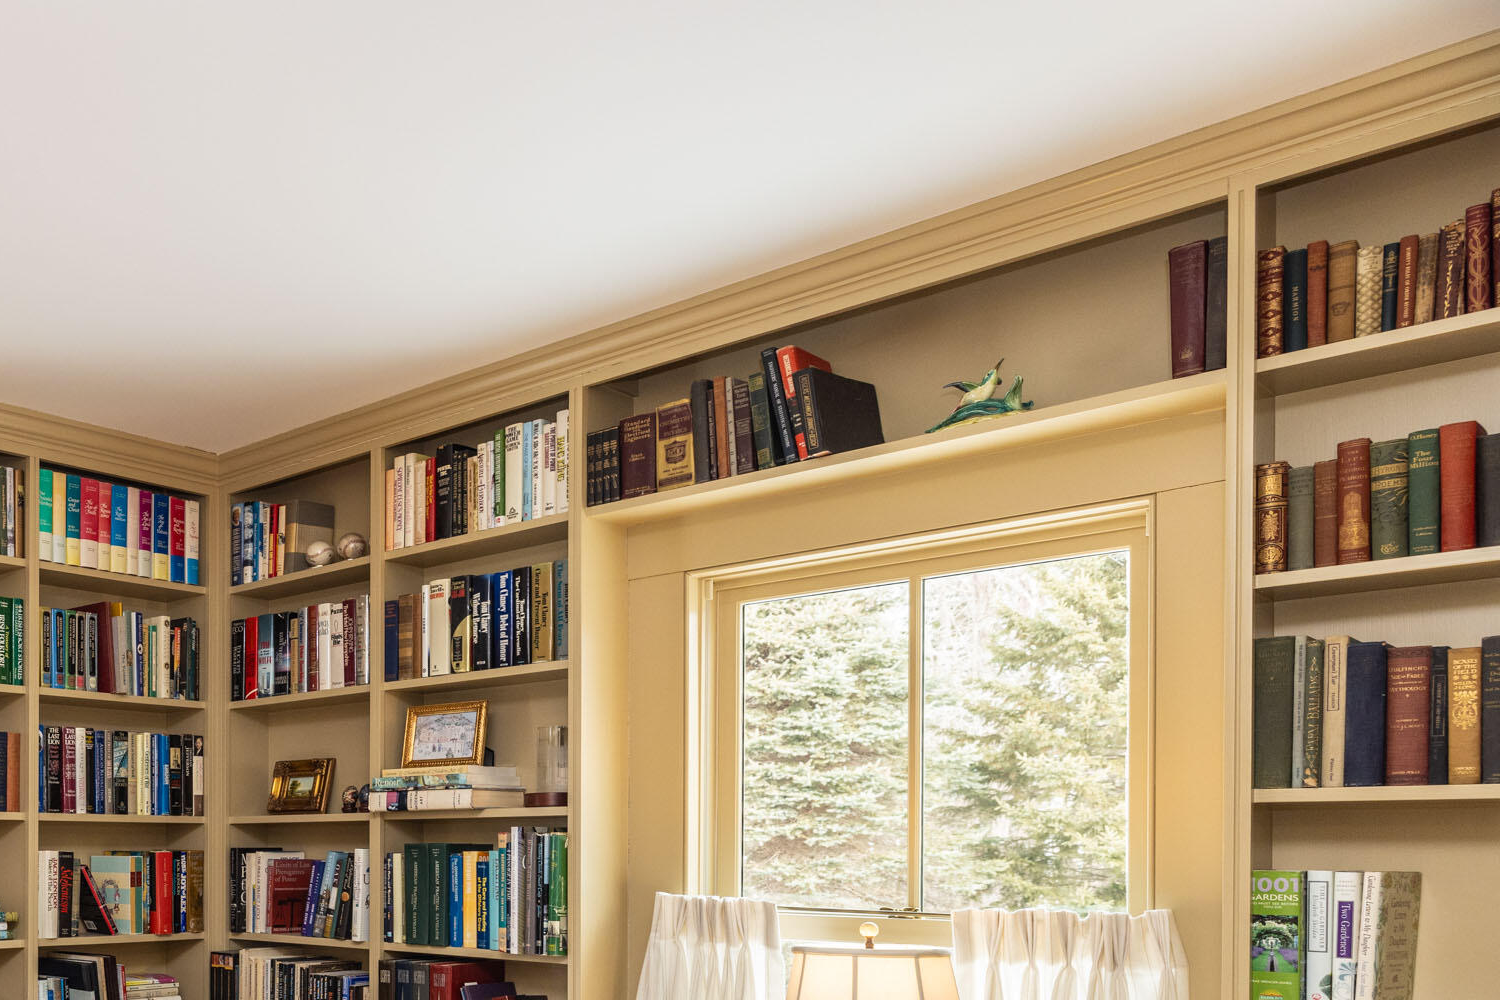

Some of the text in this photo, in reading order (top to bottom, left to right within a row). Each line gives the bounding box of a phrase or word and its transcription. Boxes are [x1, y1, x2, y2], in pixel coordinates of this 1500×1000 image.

[1291, 286, 1299, 322] MARMION
[1410, 460, 1439, 469] Million
[479, 600, 490, 634] Tom Clancy
[498, 573, 509, 662] Tom Clancy Debt of Honor
[556, 599, 563, 608] of
[533, 626, 541, 651] Danger
[1339, 904, 1351, 957] Two Gardeners
